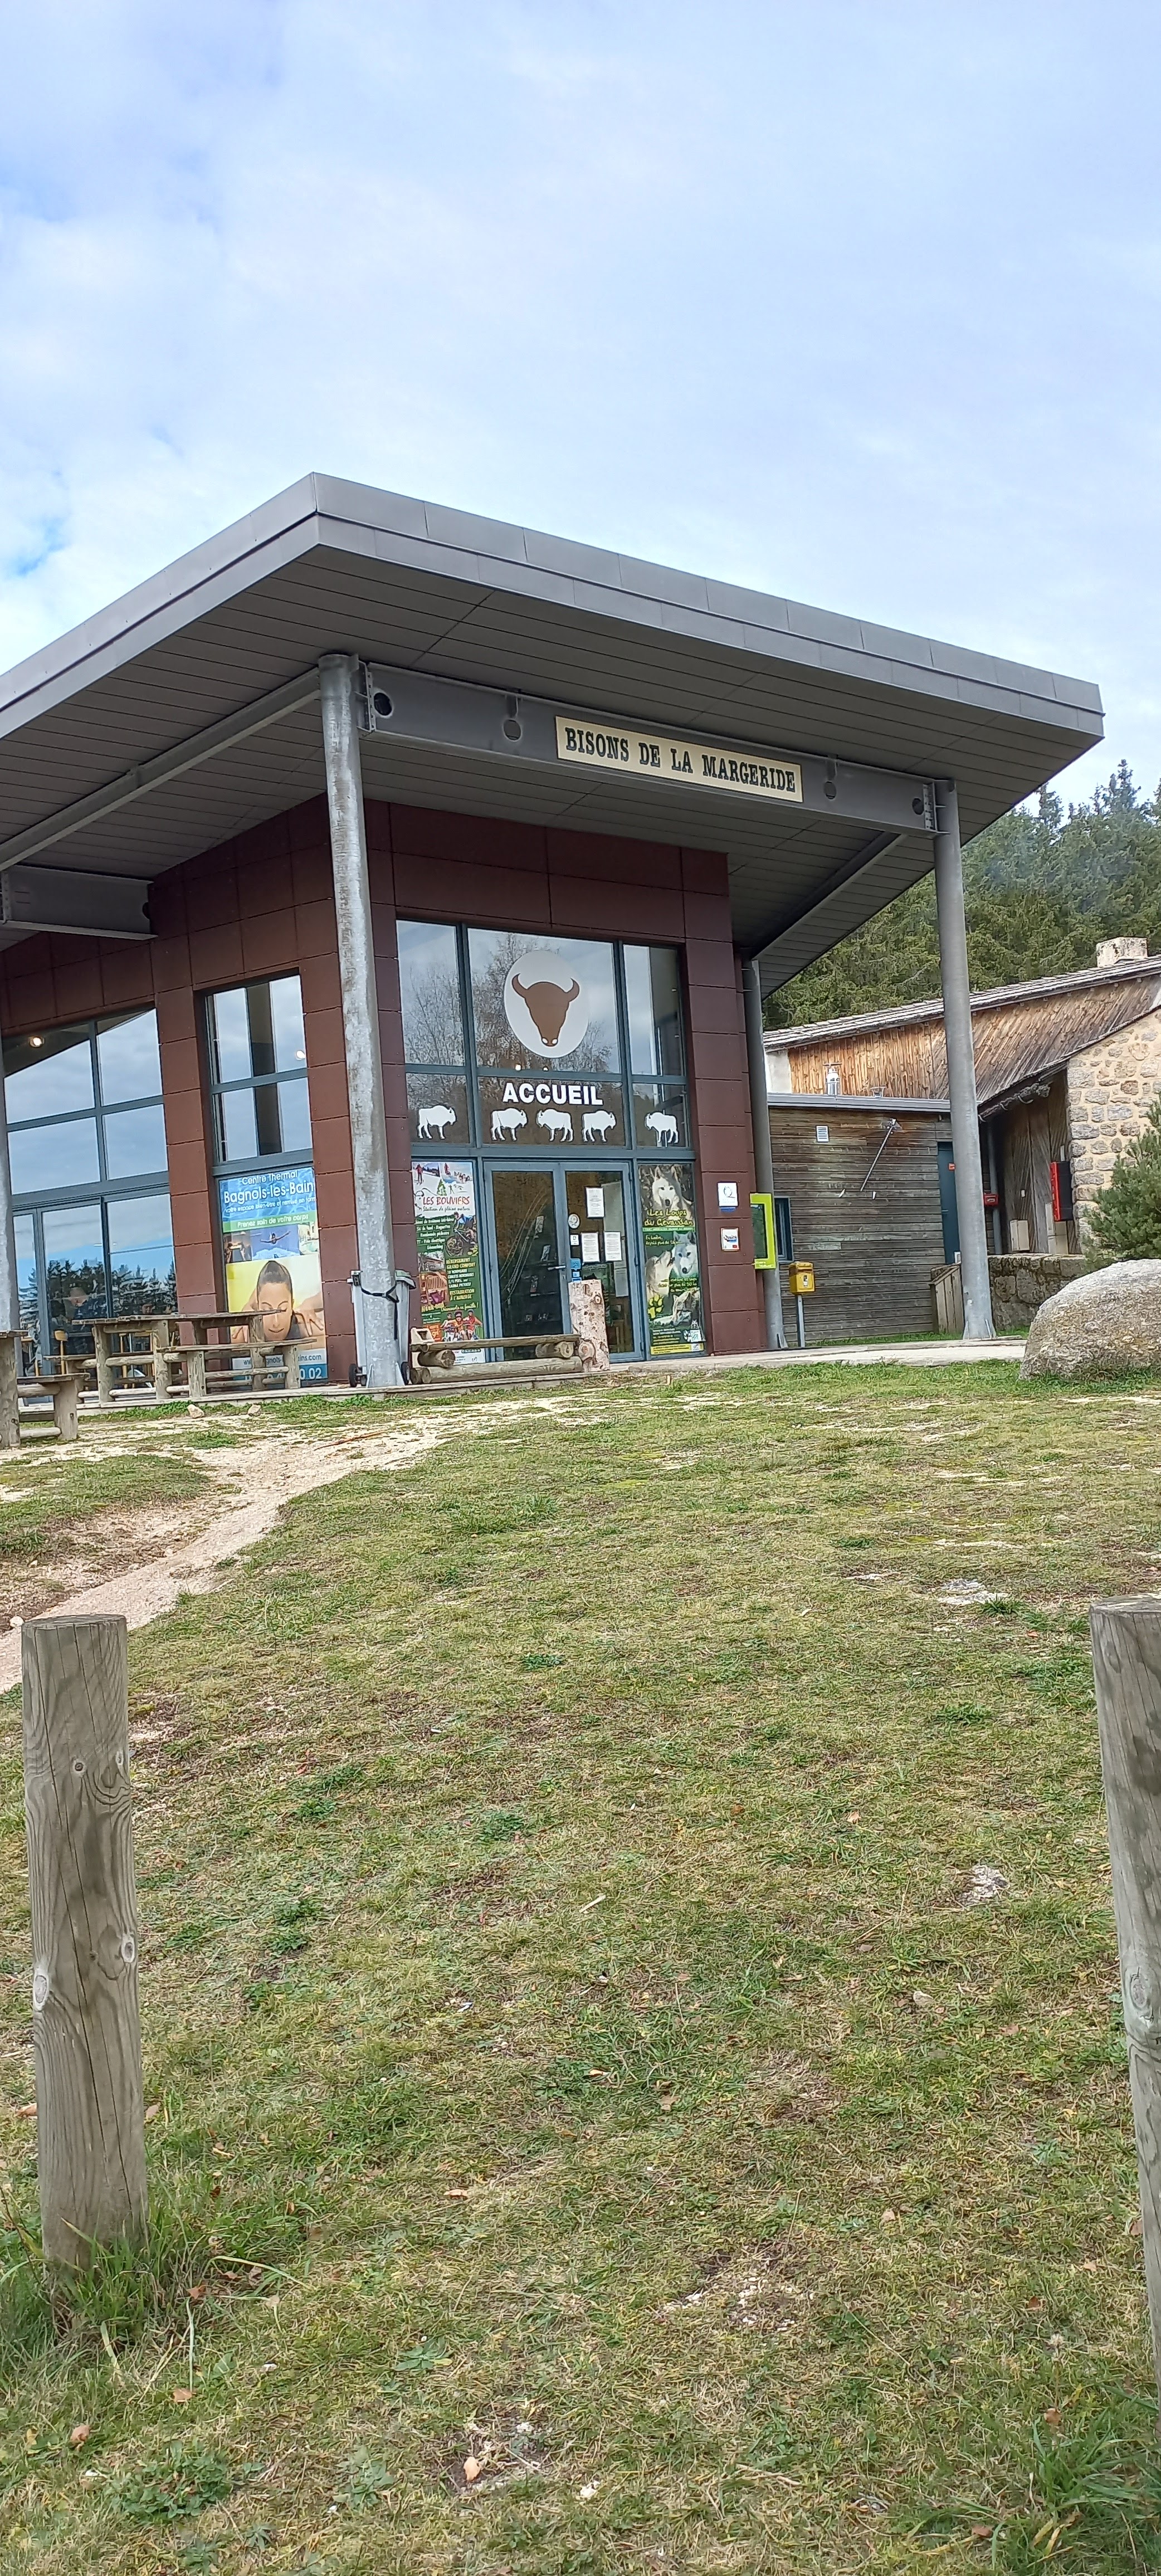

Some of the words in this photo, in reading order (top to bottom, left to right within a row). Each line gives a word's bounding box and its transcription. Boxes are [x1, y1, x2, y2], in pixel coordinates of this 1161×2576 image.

[564, 727, 630, 762] BISONS
[638, 742, 661, 768] DE
[670, 748, 694, 774] LA
[702, 754, 796, 793] MARGERIDE
[503, 1082, 603, 1106] ACCUEIL
[242, 1175, 267, 1185] Centre
[268, 1170, 298, 1182] Thermal
[223, 1180, 314, 1204] Bagnols-les-Bain
[423, 1197, 434, 1205] LES
[292, 1213, 309, 1222] corps
[666, 1208, 687, 1217] Loups
[308, 1367, 322, 1379] 02
